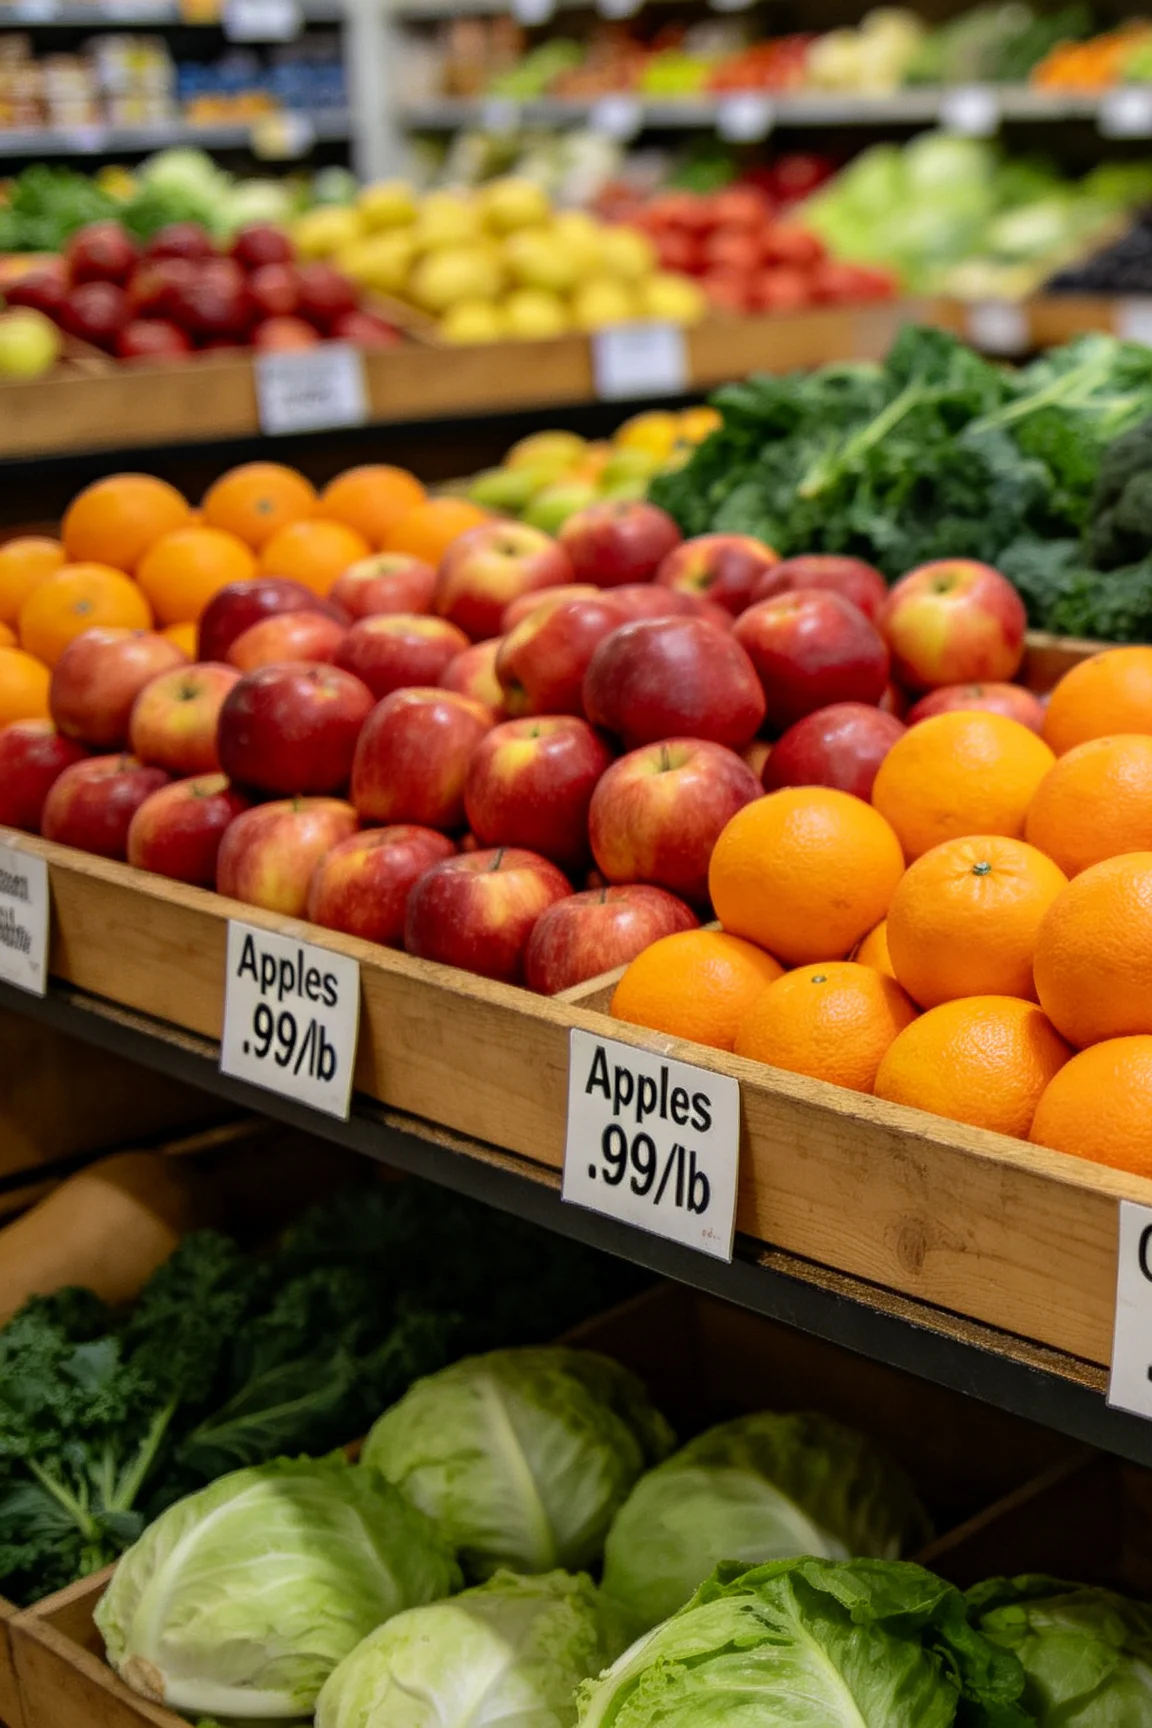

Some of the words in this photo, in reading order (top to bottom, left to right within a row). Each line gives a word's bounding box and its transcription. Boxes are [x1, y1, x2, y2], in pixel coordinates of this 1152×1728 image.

[237, 933, 338, 1008] Apples
[242, 1002, 337, 1082] .99/lb
[585, 1045, 712, 1133] Apples
[588, 1123, 711, 1215] .99/lb
